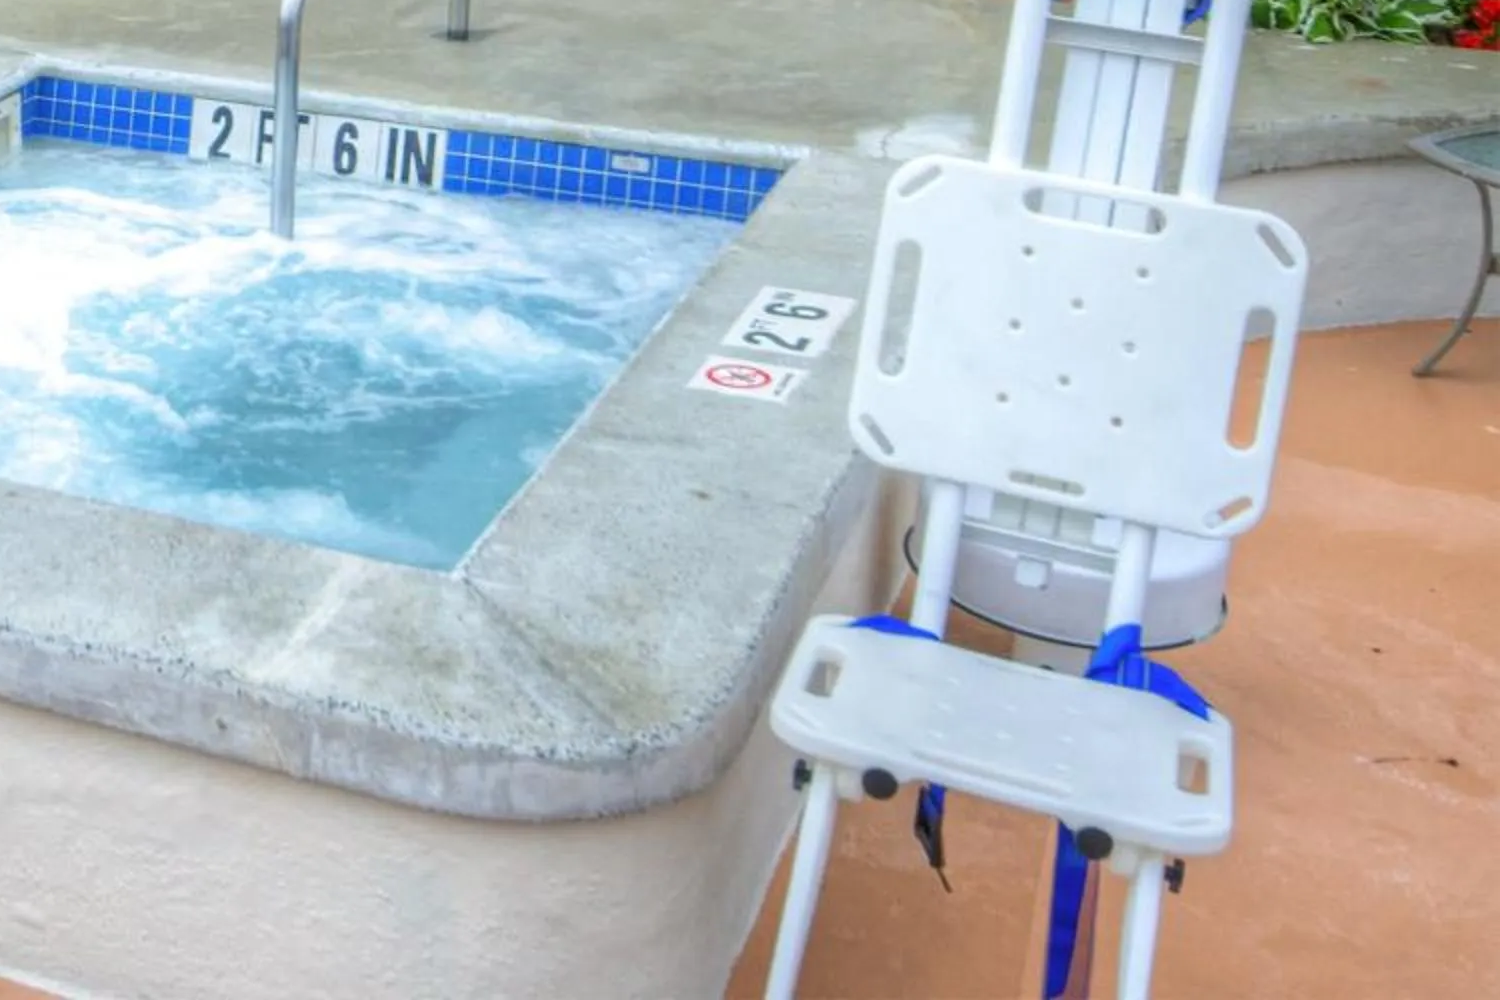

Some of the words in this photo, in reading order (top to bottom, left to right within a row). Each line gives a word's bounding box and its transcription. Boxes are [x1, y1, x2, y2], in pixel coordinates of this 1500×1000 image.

[208, 105, 234, 160] 2
[333, 121, 359, 176] 6
[385, 127, 438, 187] IN
[763, 302, 829, 321] 6
[741, 331, 812, 352] 2
